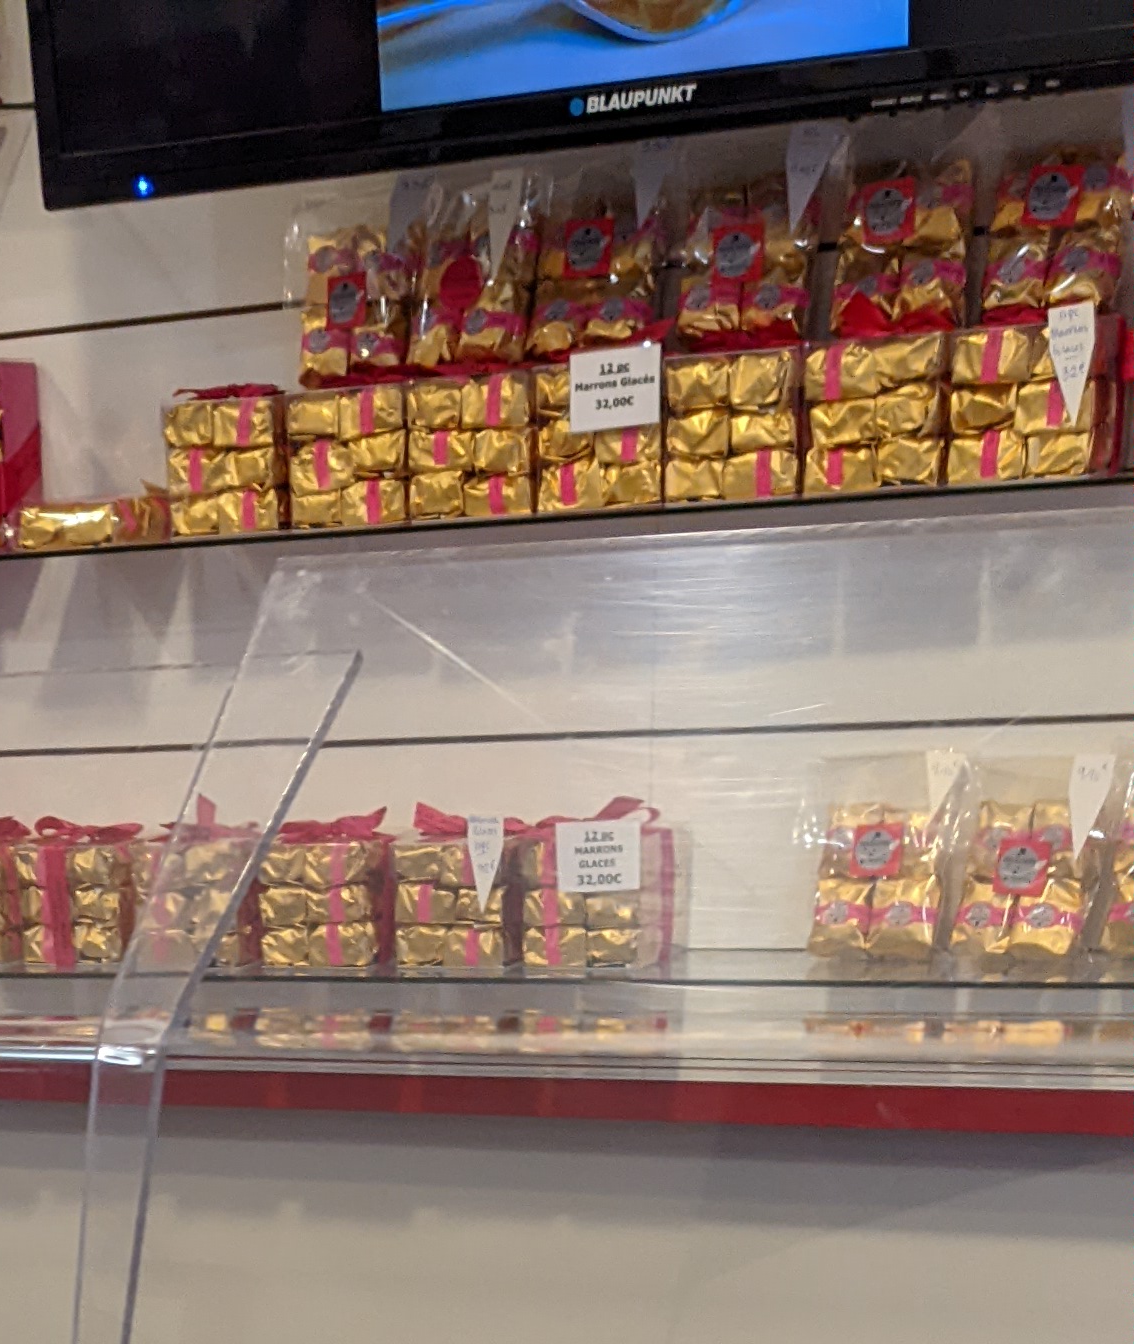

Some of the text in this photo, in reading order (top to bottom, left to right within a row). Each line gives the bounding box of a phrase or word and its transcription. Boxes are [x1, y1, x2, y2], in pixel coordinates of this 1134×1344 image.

[586, 83, 697, 114] BLAUPUNKT
[575, 380, 618, 392] Marrons
[595, 396, 634, 410] 32,00€
[574, 845, 624, 854] MARRONS
[579, 859, 616, 868] GLACES
